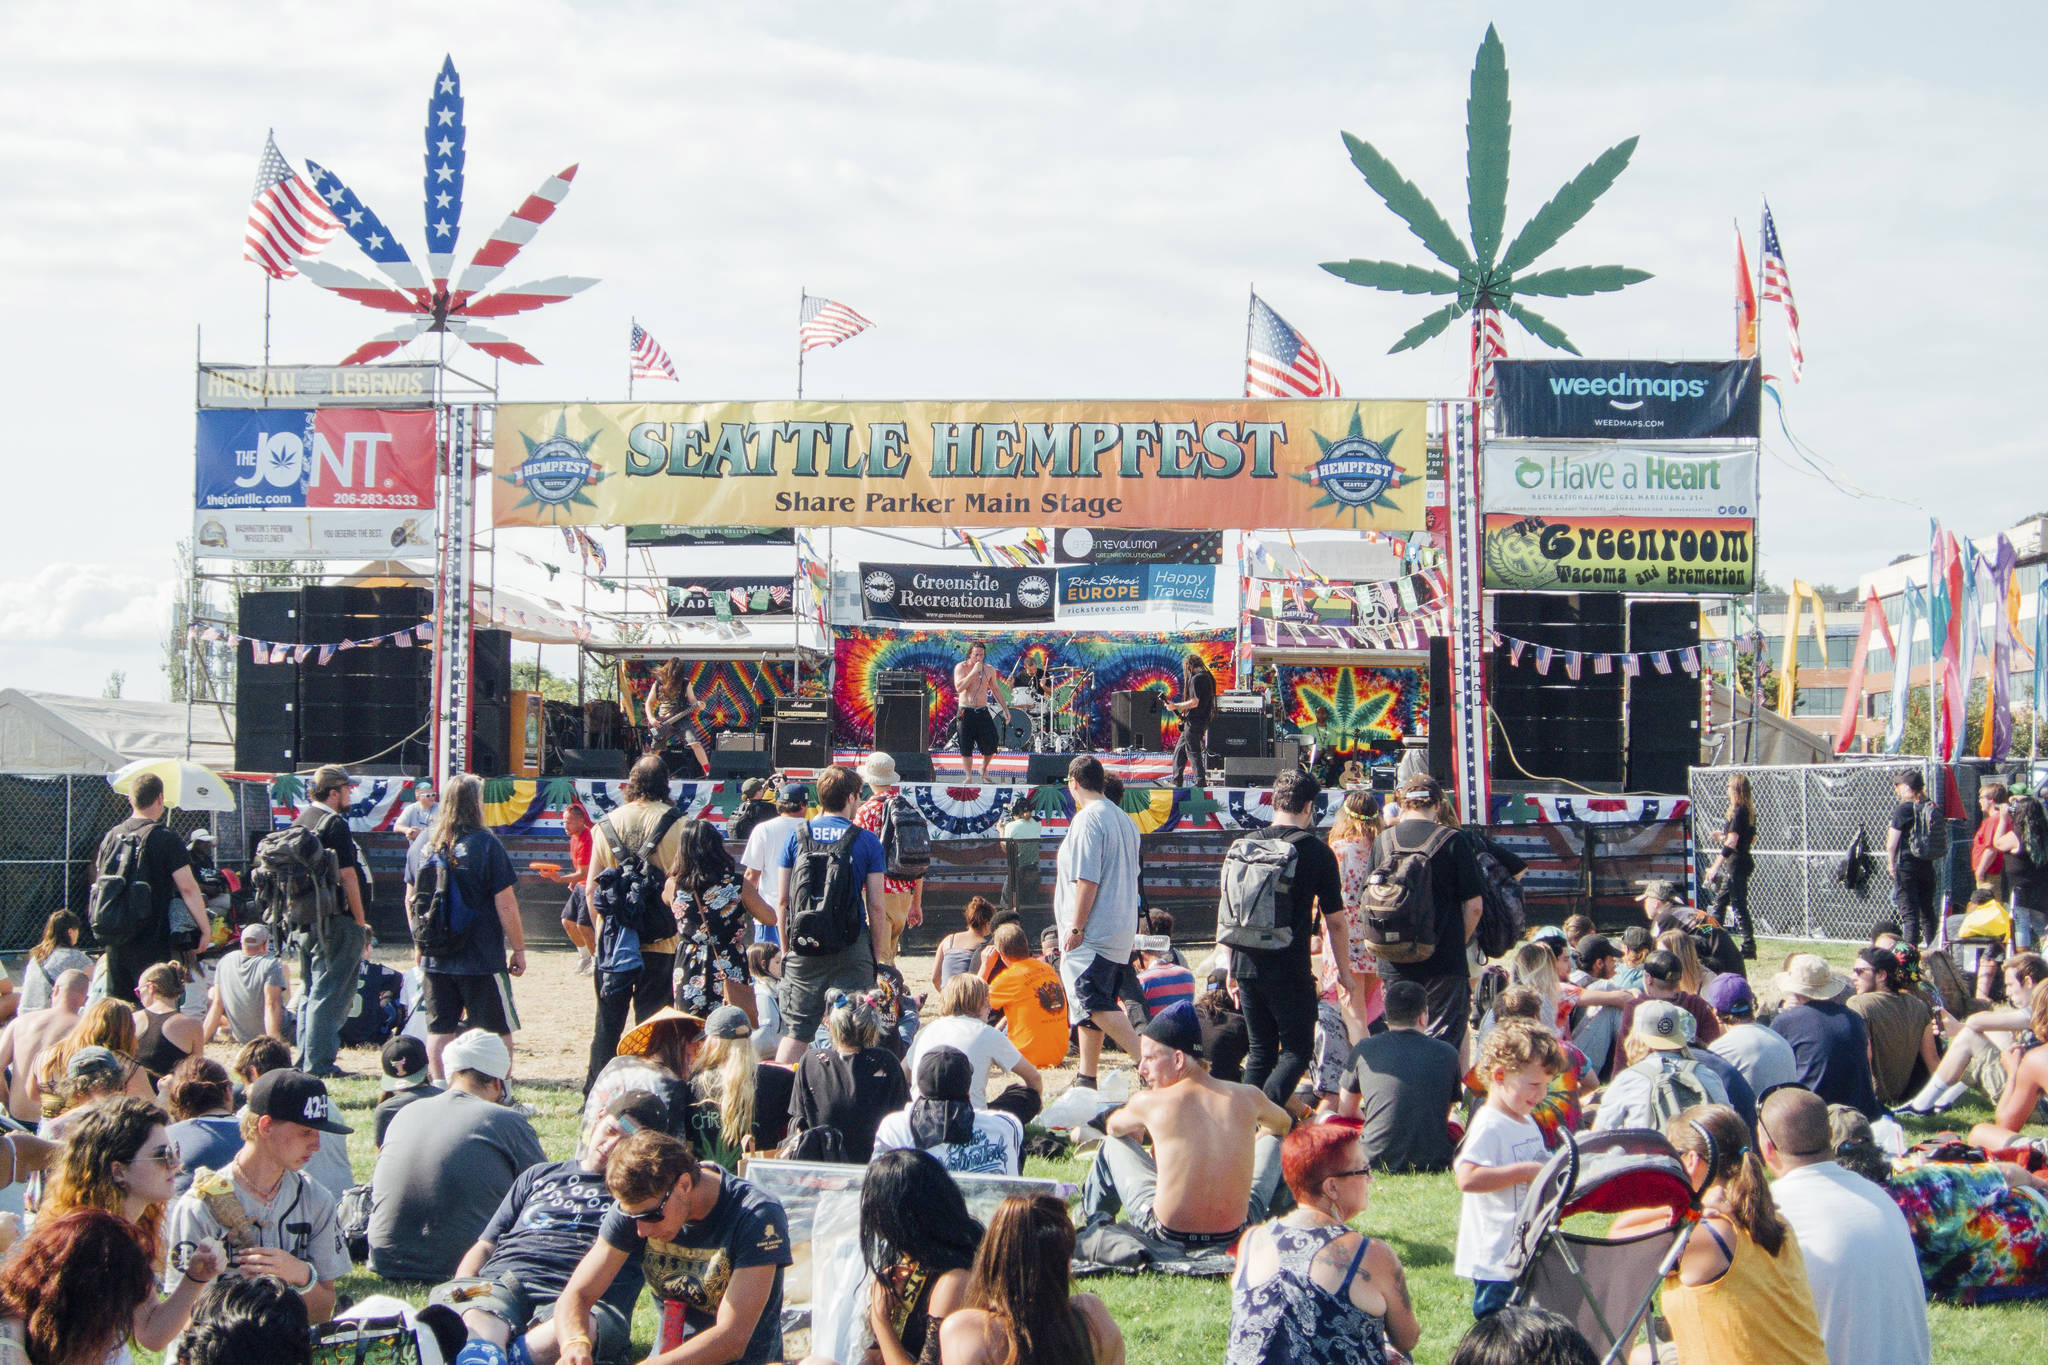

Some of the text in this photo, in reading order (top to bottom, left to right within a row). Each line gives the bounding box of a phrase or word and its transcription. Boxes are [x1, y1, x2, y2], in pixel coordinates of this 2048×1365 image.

[331, 372, 424, 396] LEGENDS
[1549, 372, 1706, 402] weedmaps
[1594, 418, 1665, 428] WEEDMAPS.COM
[625, 420, 1288, 479] SEATTLE HEMPFEST
[235, 450, 257, 467] THE
[523, 461, 590, 476] HEMPFEST
[1319, 461, 1392, 477] HEMPFEST
[1550, 458, 1721, 490] Have a Heart
[206, 493, 292, 508] thejointllc.com
[333, 493, 418, 507] 206-283-3333
[775, 491, 1123, 517] Share Parker Main Stage
[1539, 524, 1749, 562] Greenroom
[912, 573, 1000, 592] Greenside
[1068, 576, 1098, 588] Rick
[1155, 570, 1207, 587] Happy
[1556, 565, 1627, 584] Tacoma
[1667, 565, 1745, 585] Bremerton
[899, 590, 1012, 609] Recreational
[1067, 585, 1140, 601] EUROPE
[1153, 584, 1210, 600] Travels!
[1067, 605, 1140, 615] ricksteves.com
[1471, 610, 1488, 707] FREEDOM
[812, 827, 845, 841] BEM
